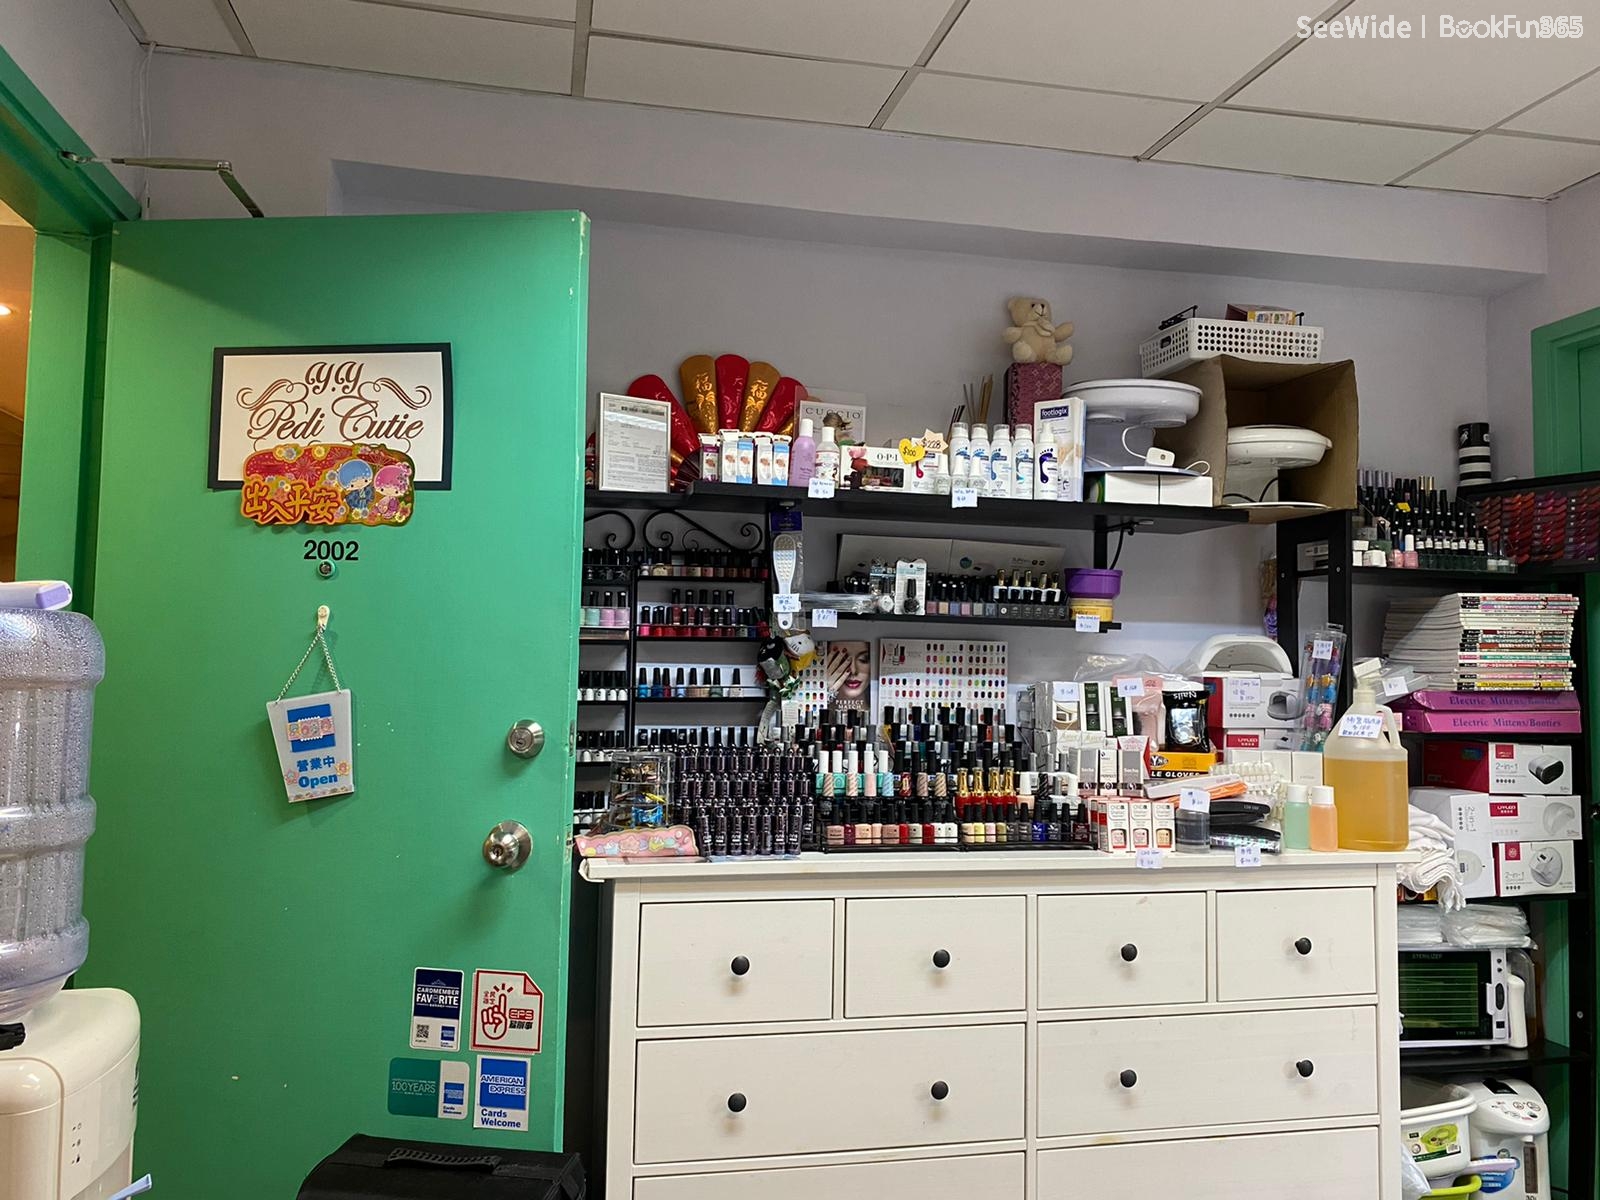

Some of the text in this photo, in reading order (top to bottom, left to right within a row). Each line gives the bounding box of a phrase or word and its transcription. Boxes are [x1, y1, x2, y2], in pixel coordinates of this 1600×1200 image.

[247, 396, 424, 440] Pedi Cutie
[1041, 407, 1068, 418] footlogix
[245, 483, 339, 521] 出入平安
[303, 540, 359, 561] 2002
[1449, 696, 1486, 706] Electric
[1452, 718, 1562, 728] Electric Mittens/Booties
[298, 774, 338, 788] Open
[416, 987, 460, 996] CARDMEMBER
[510, 1009, 533, 1020] EPS
[480, 1074, 524, 1085] AMERICAN
[488, 1084, 527, 1096] EXPRESS
[481, 1108, 507, 1118] Cards
[481, 1117, 522, 1128] Welcome
